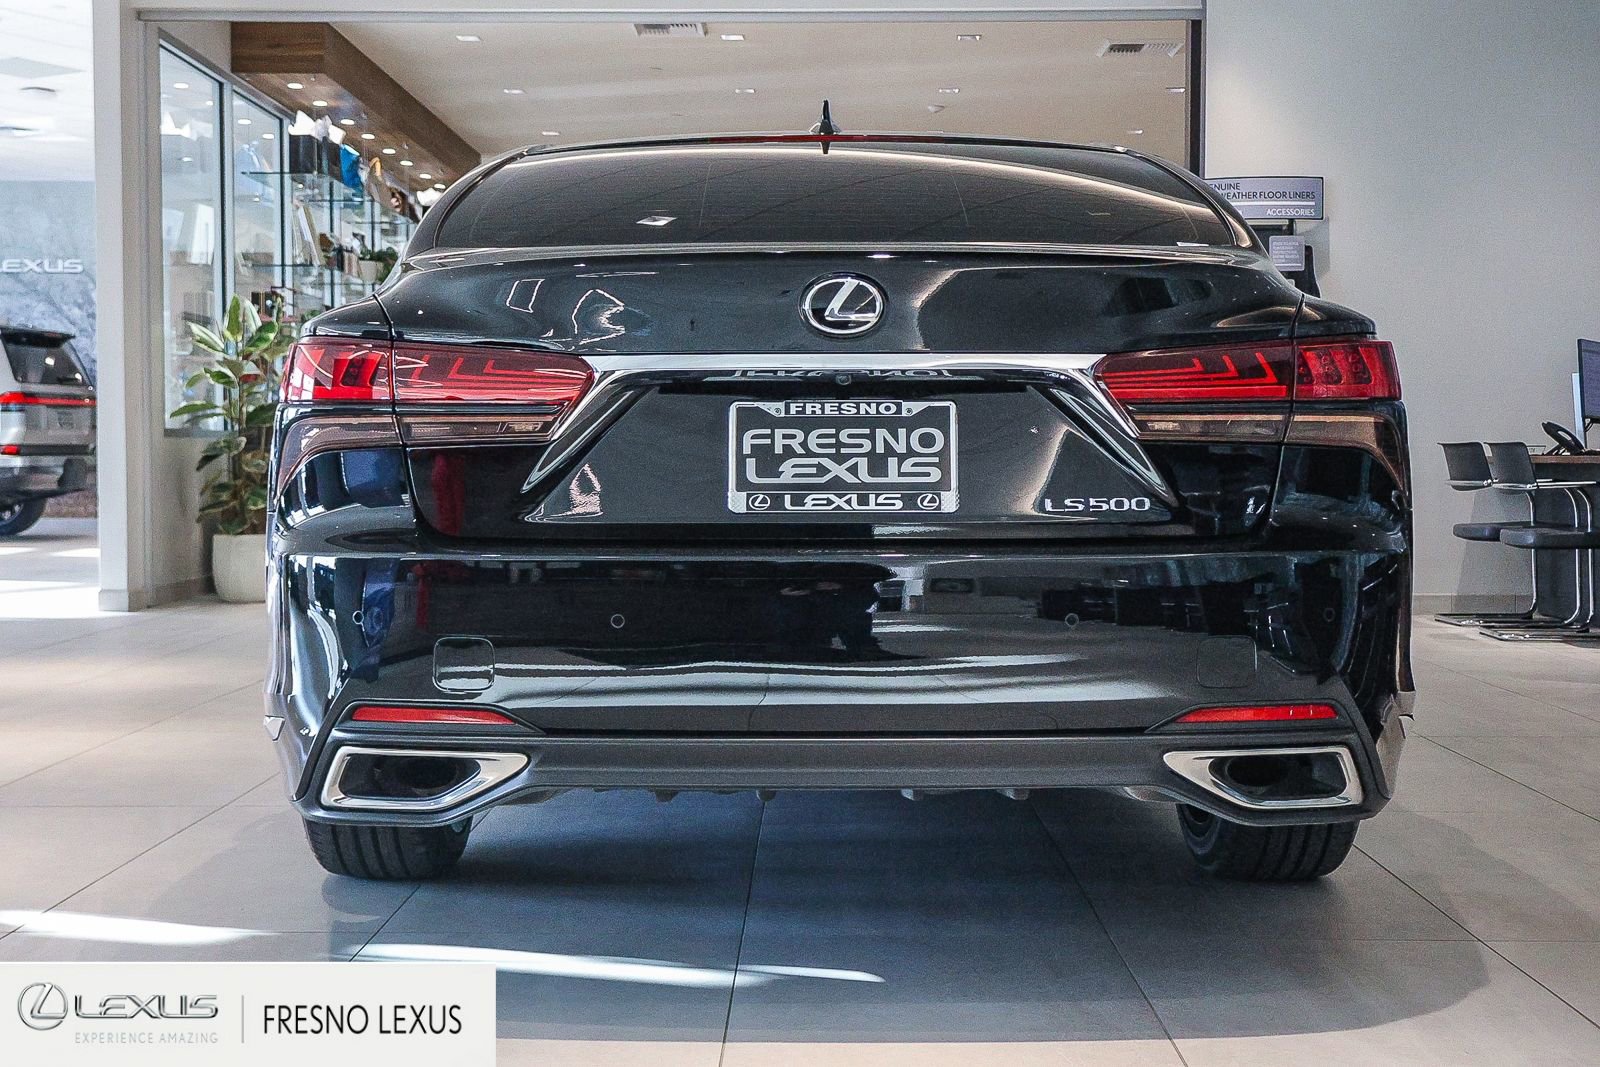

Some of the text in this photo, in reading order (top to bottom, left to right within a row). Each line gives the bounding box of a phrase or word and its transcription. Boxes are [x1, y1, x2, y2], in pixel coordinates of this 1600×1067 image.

[1259, 191, 1288, 200] FLOOR
[1288, 191, 1316, 200] LINERS
[1266, 208, 1315, 217] ACCESSORIES
[0, 258, 84, 274] EXUS
[789, 402, 897, 415] FRESNO
[742, 427, 945, 455] FRESNO
[745, 456, 942, 484] LEXUS
[784, 493, 904, 511] LEXUS
[1044, 497, 1151, 512] LS 500
